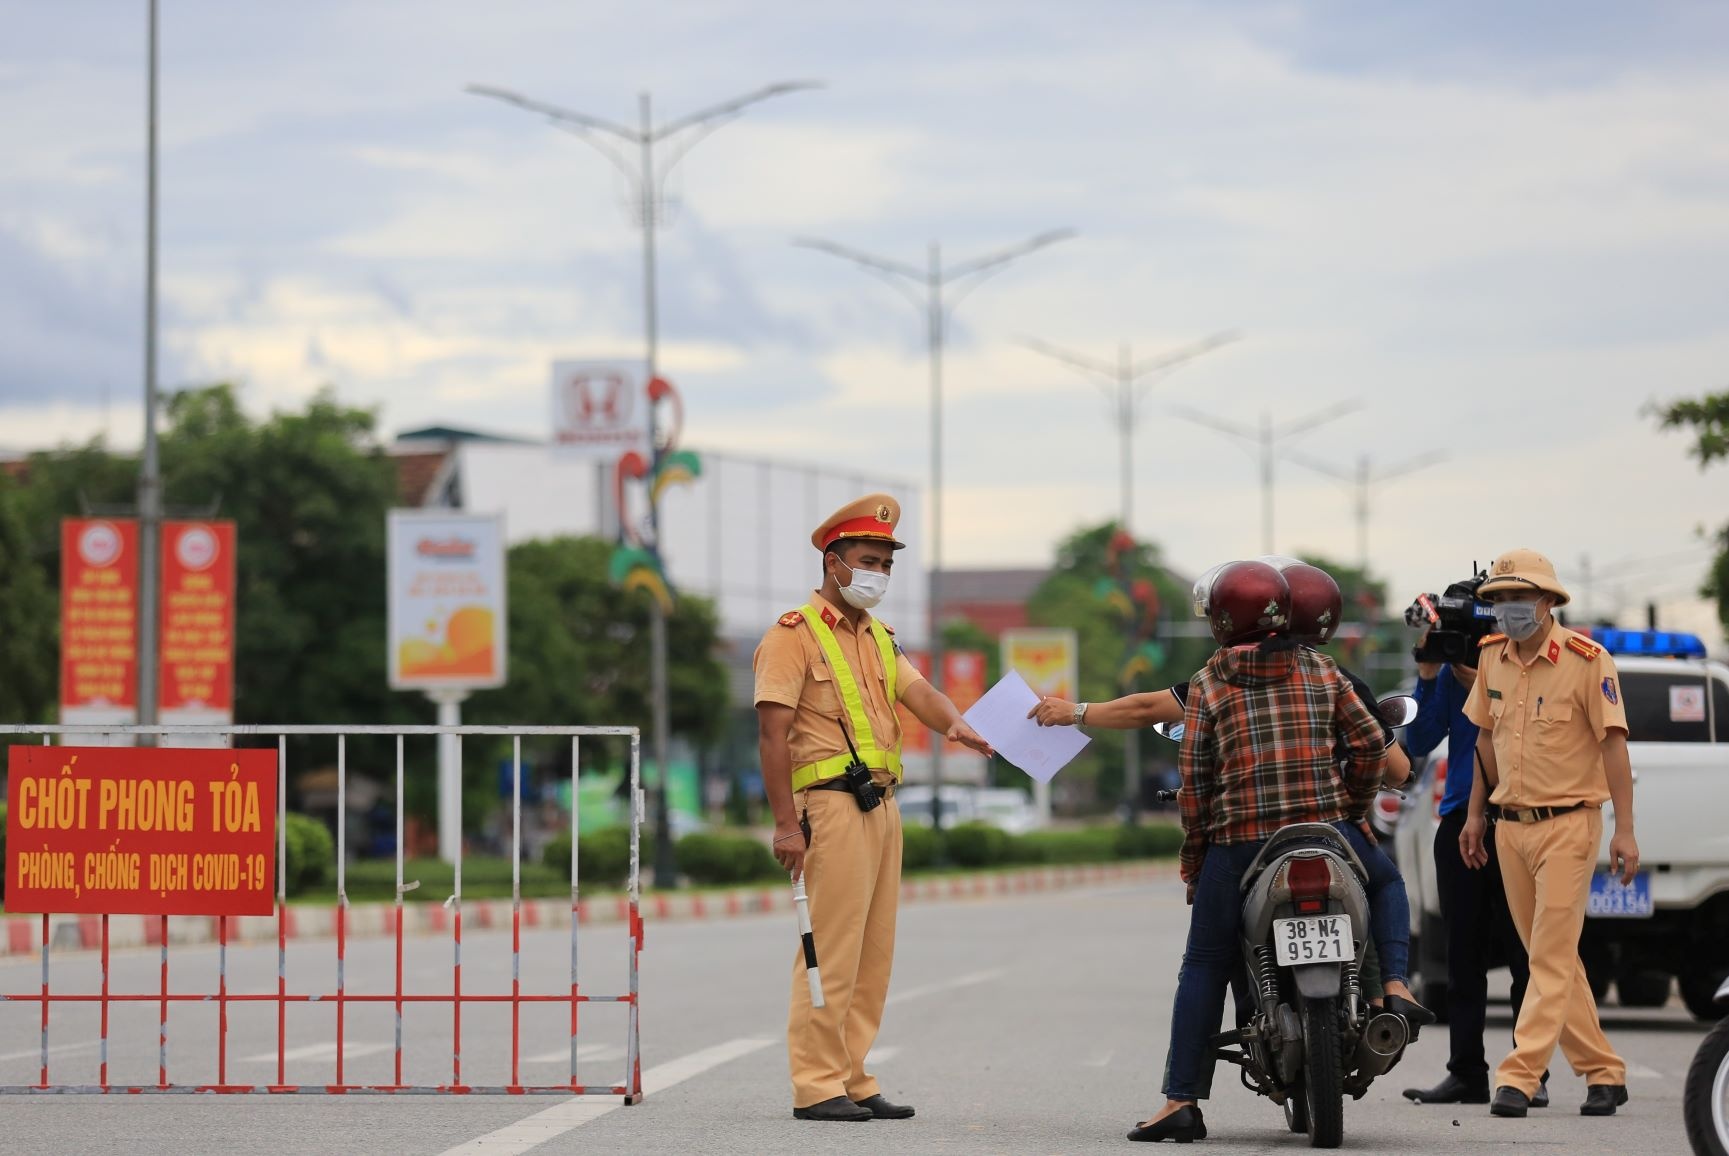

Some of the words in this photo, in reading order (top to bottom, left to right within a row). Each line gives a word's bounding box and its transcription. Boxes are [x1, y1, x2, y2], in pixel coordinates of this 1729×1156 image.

[19, 756, 91, 829] CHỐT
[99, 779, 195, 832] PHONG
[209, 763, 261, 832] TỎA
[18, 844, 80, 898] PHÒNG,
[84, 838, 140, 890] CHỐNG
[150, 854, 188, 898] DỊCH
[193, 854, 265, 891] COVID-19
[1286, 919, 1340, 940] 38-N4
[1288, 939, 1341, 961] 9521
